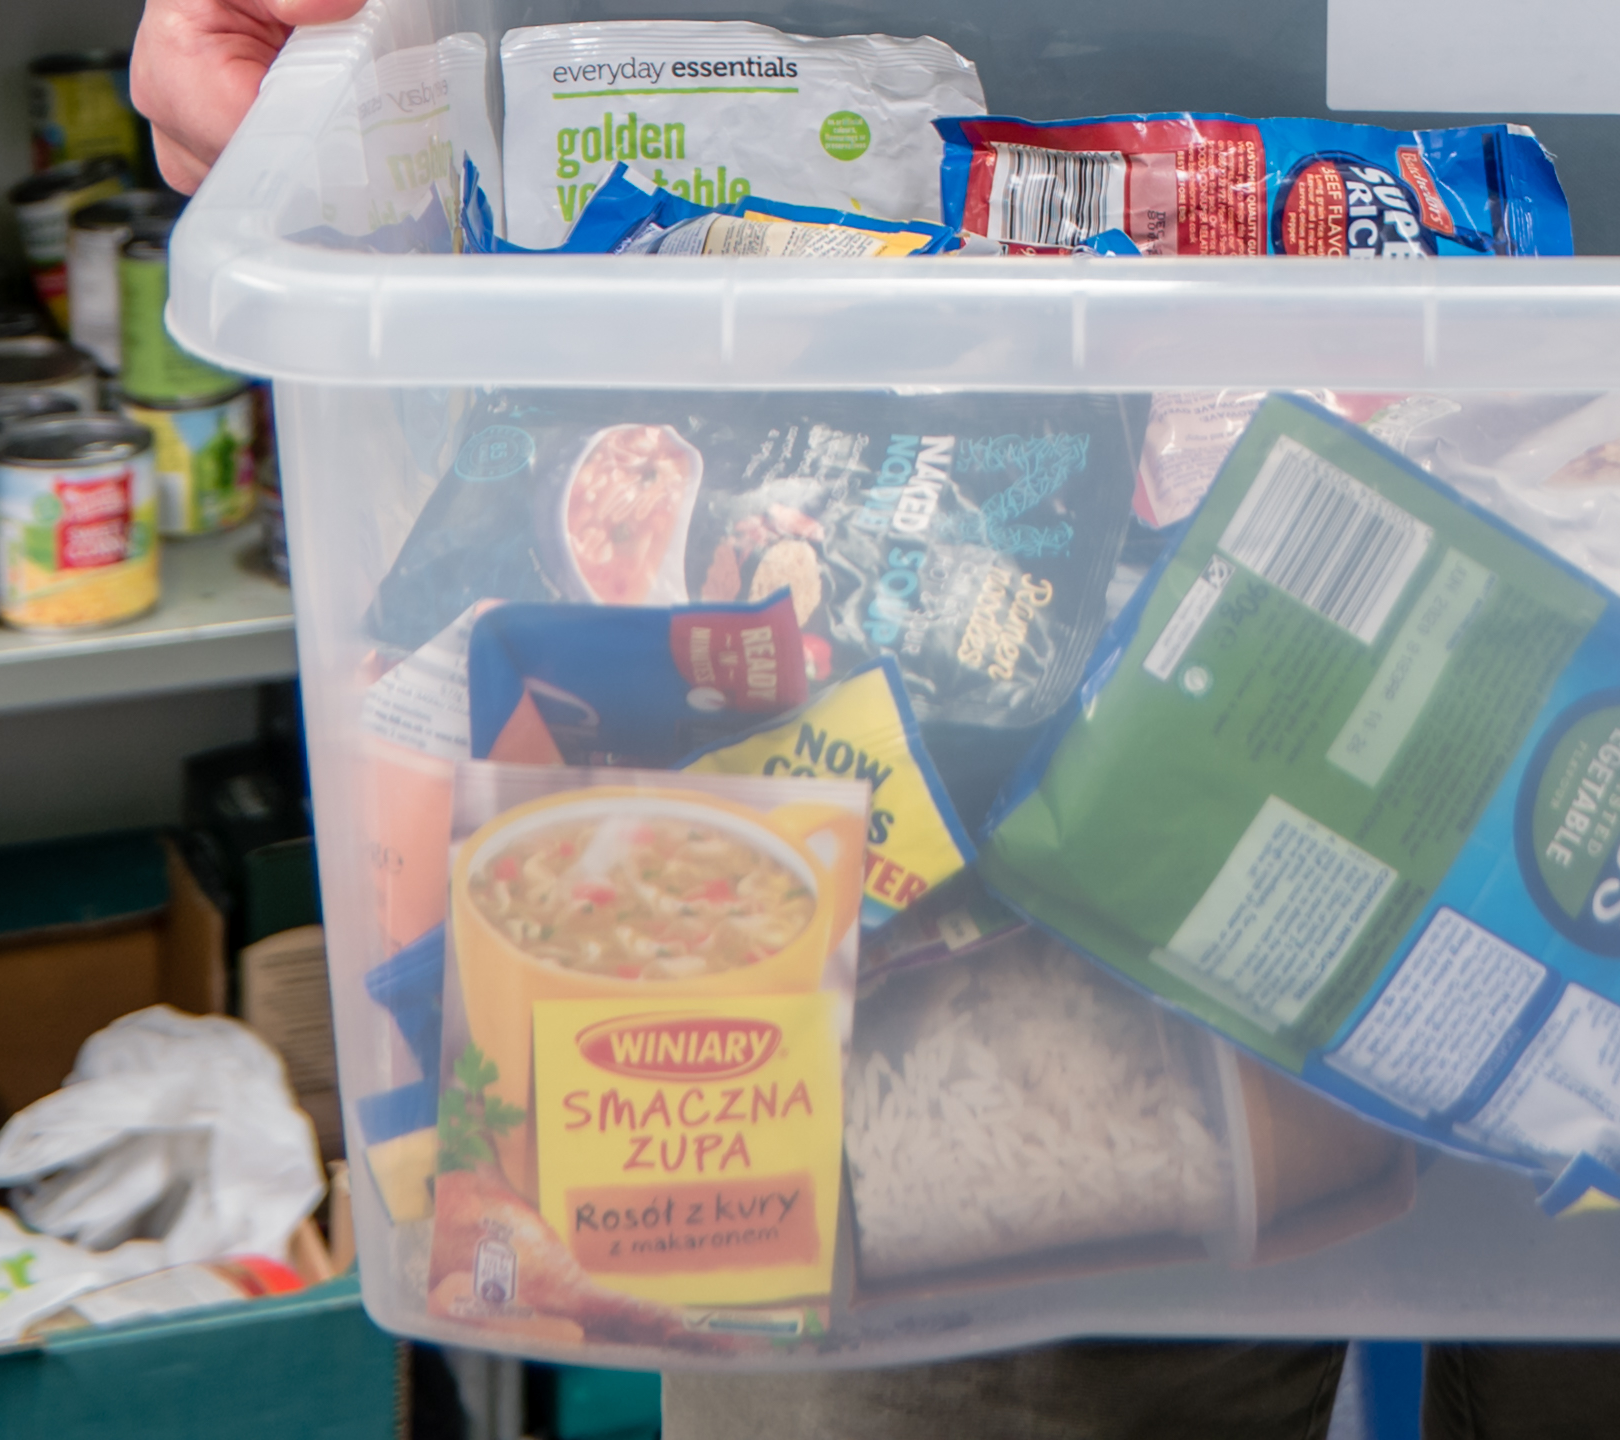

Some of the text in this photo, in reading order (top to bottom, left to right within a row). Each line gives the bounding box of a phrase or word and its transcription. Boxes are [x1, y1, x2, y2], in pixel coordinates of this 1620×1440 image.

[552, 56, 798, 84] everyday essentials
[556, 111, 686, 179] golden
[892, 435, 955, 534] NAKED
[958, 566, 1012, 665] Noodles
[989, 573, 1053, 680] Ramen
[689, 626, 716, 685] MINUTES
[740, 626, 778, 701] READY
[793, 722, 895, 794] NOW
[607, 1029, 777, 1068] WINIARY
[560, 1079, 815, 1134] SMACZNA
[621, 1132, 754, 1175] ZUPA
[575, 1185, 801, 1236] Rosół z kury
[608, 1225, 781, 1258] z makaronem
